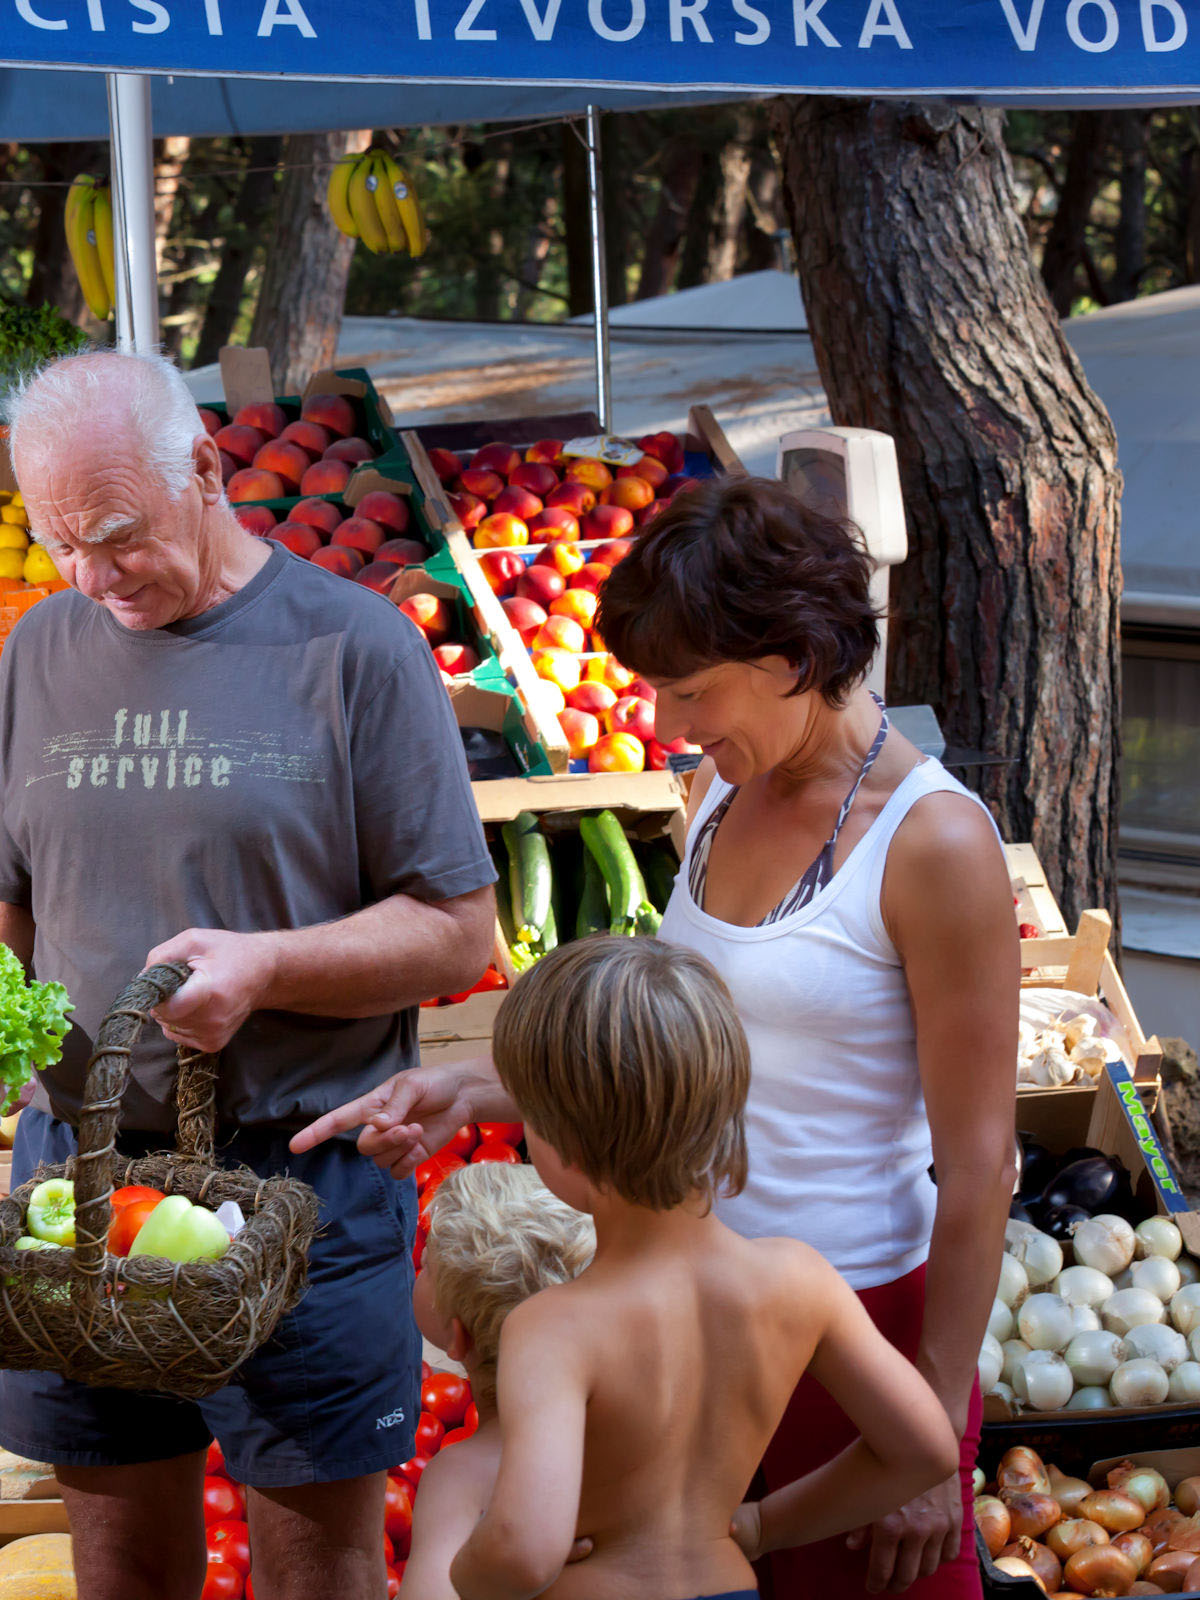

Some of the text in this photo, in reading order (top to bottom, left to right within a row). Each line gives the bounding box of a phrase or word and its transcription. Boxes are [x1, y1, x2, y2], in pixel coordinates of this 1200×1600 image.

[414, 0, 914, 50] IZVORSKA
[114, 707, 189, 749] full
[66, 749, 232, 789] service
[1116, 1080, 1178, 1195] Mayer
